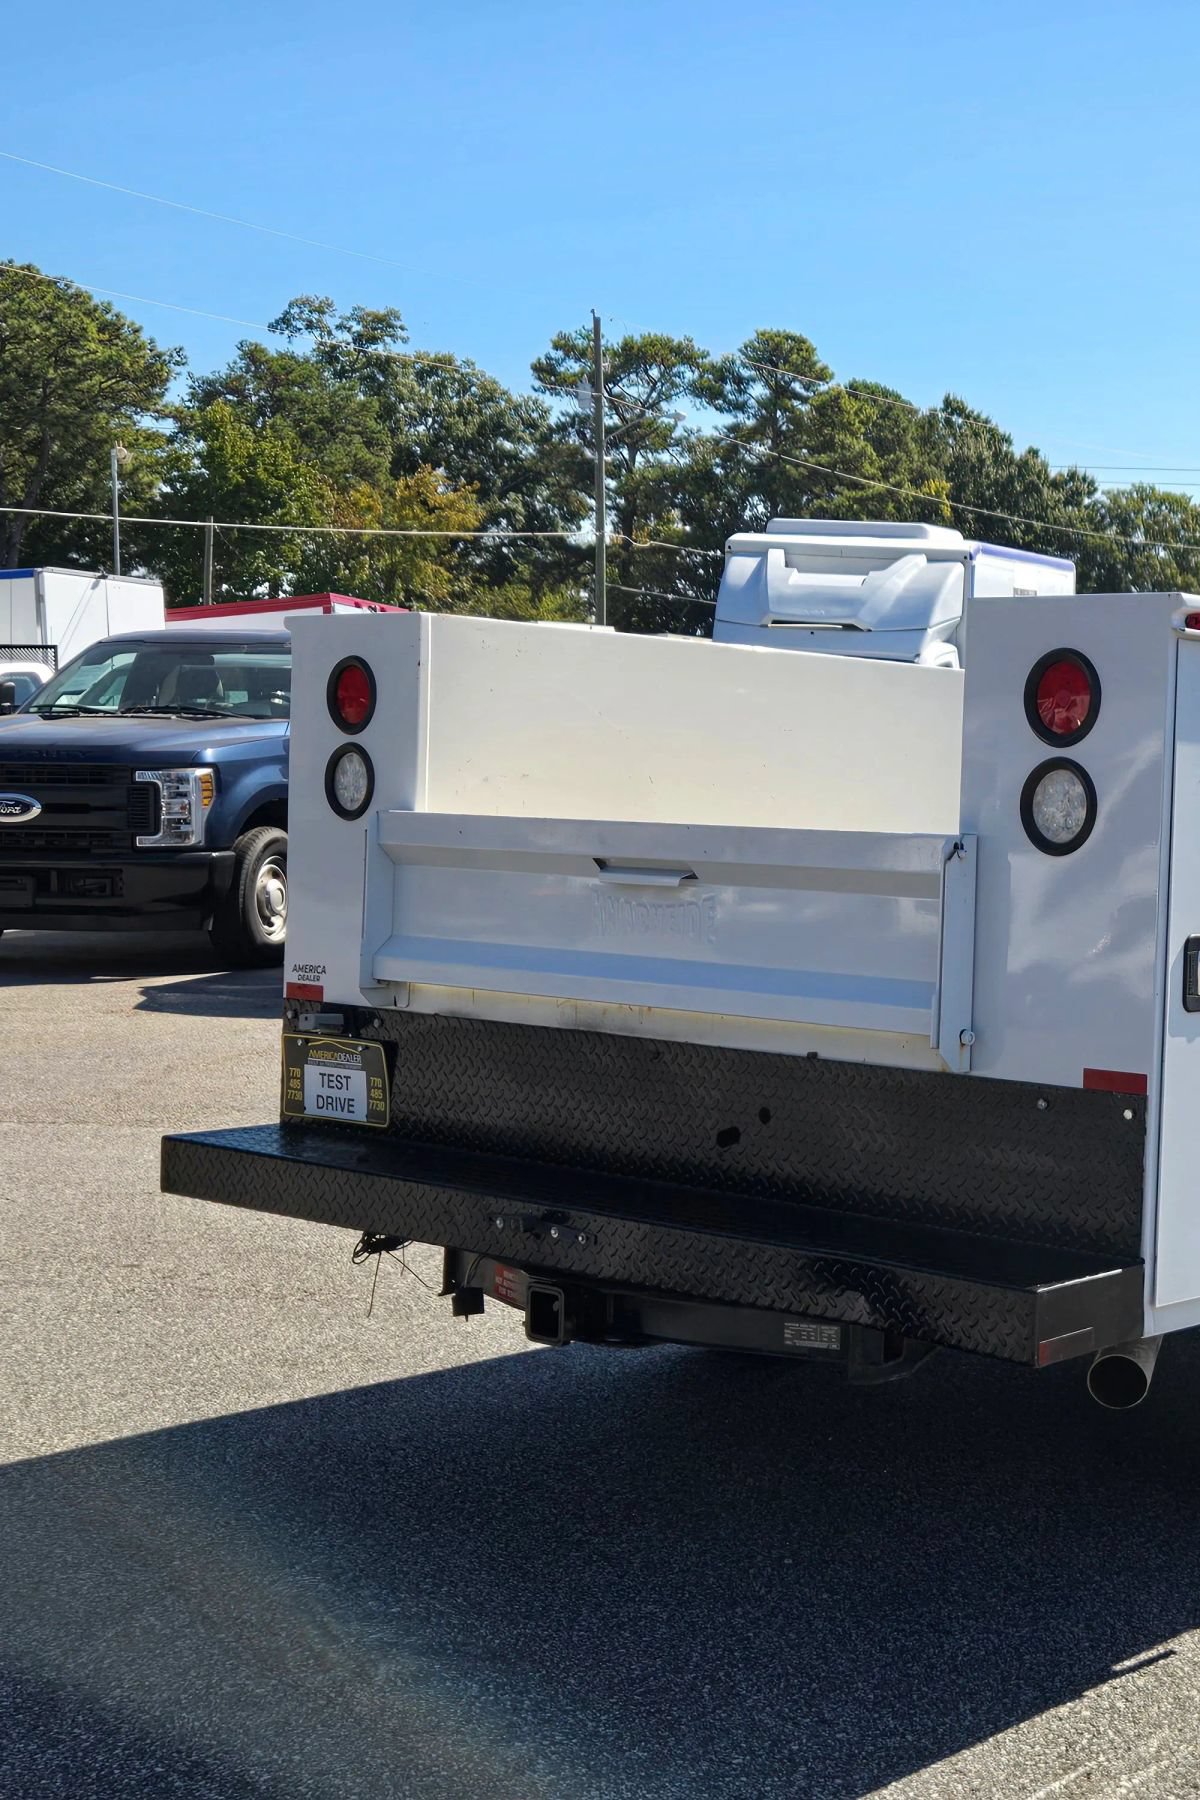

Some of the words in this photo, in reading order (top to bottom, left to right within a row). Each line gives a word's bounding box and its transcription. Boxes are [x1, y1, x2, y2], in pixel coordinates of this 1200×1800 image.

[292, 963, 326, 975] AMERICA
[297, 974, 321, 982] DEALER
[289, 1067, 301, 1077] 770
[289, 1078, 301, 1089] 485
[319, 1072, 352, 1091] TEST
[370, 1077, 382, 1088] 770
[287, 1089, 303, 1101] 7730
[370, 1088, 382, 1099] 485
[316, 1094, 355, 1114] DRIVE
[369, 1100, 385, 1111] 7730
